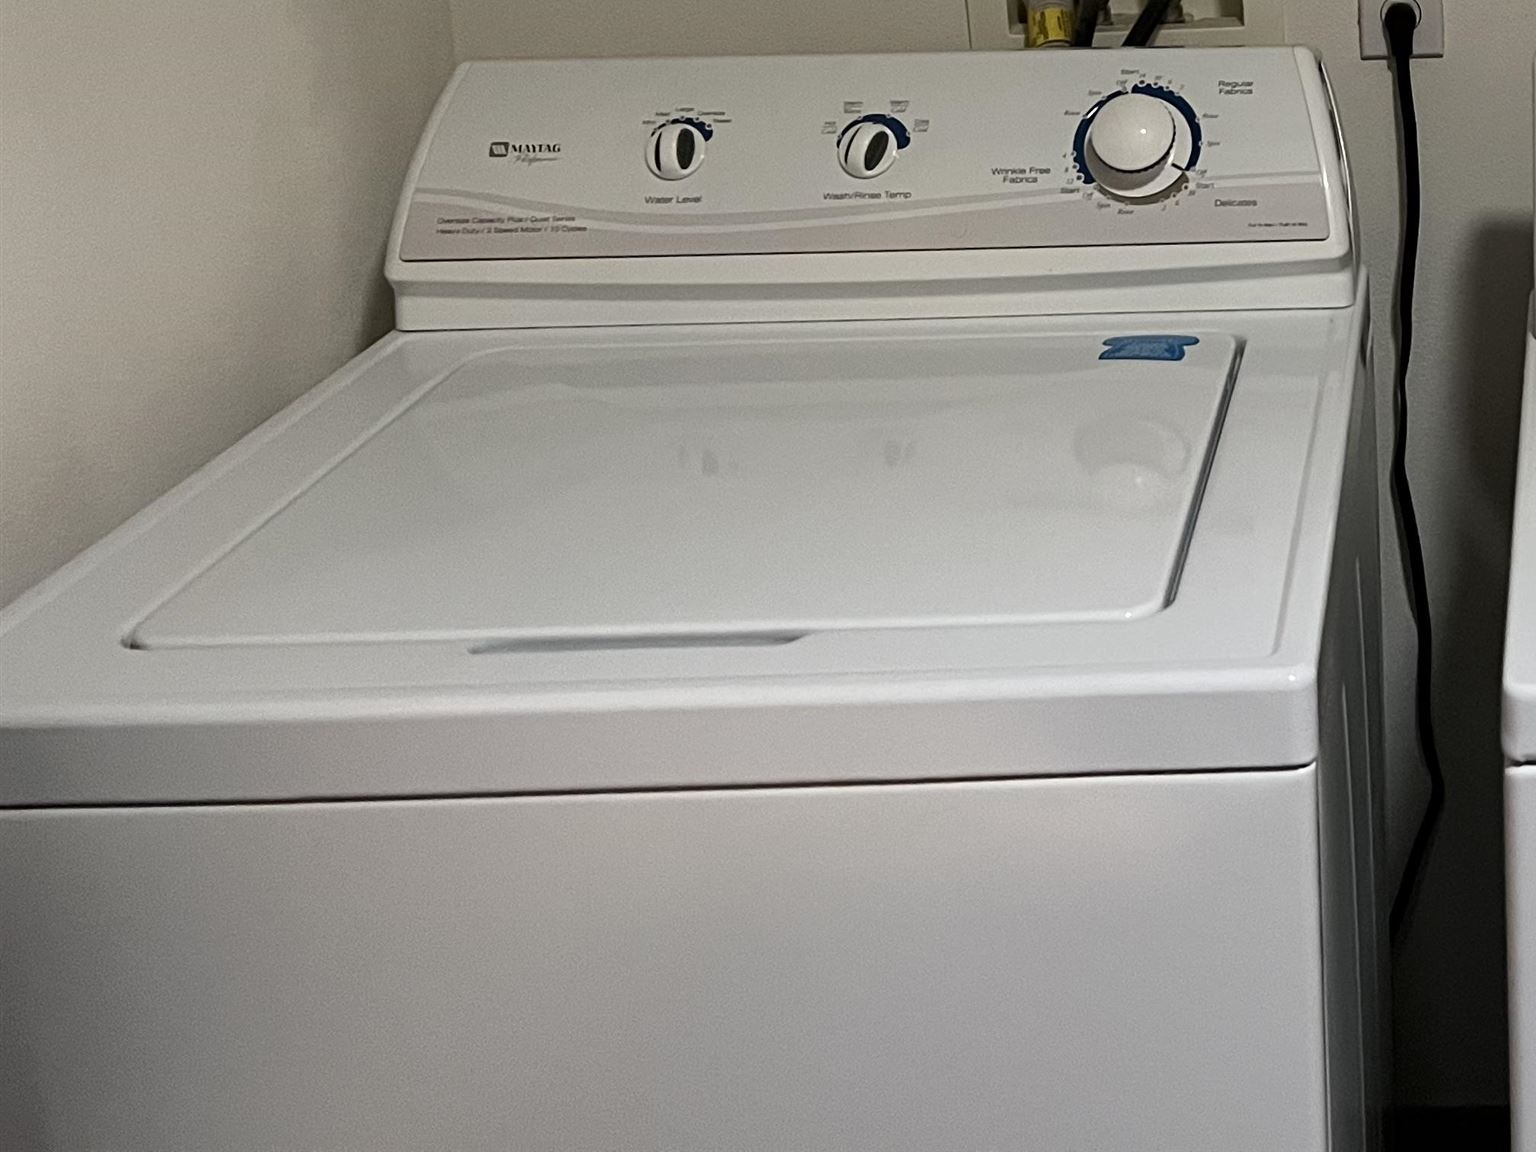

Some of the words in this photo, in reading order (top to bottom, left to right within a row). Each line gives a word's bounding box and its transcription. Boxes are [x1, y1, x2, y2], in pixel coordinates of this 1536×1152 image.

[1218, 80, 1254, 89] Regular
[511, 143, 561, 153] MAYTAG
[991, 167, 1027, 176] Wrinkle
[1029, 166, 1052, 175] Free
[1002, 175, 1039, 184] Fabrics
[644, 195, 674, 204] Water
[675, 195, 703, 204] Level
[823, 191, 882, 201] Wash/Rinse
[884, 189, 913, 200] Temp
[1214, 198, 1258, 208] Delicates
